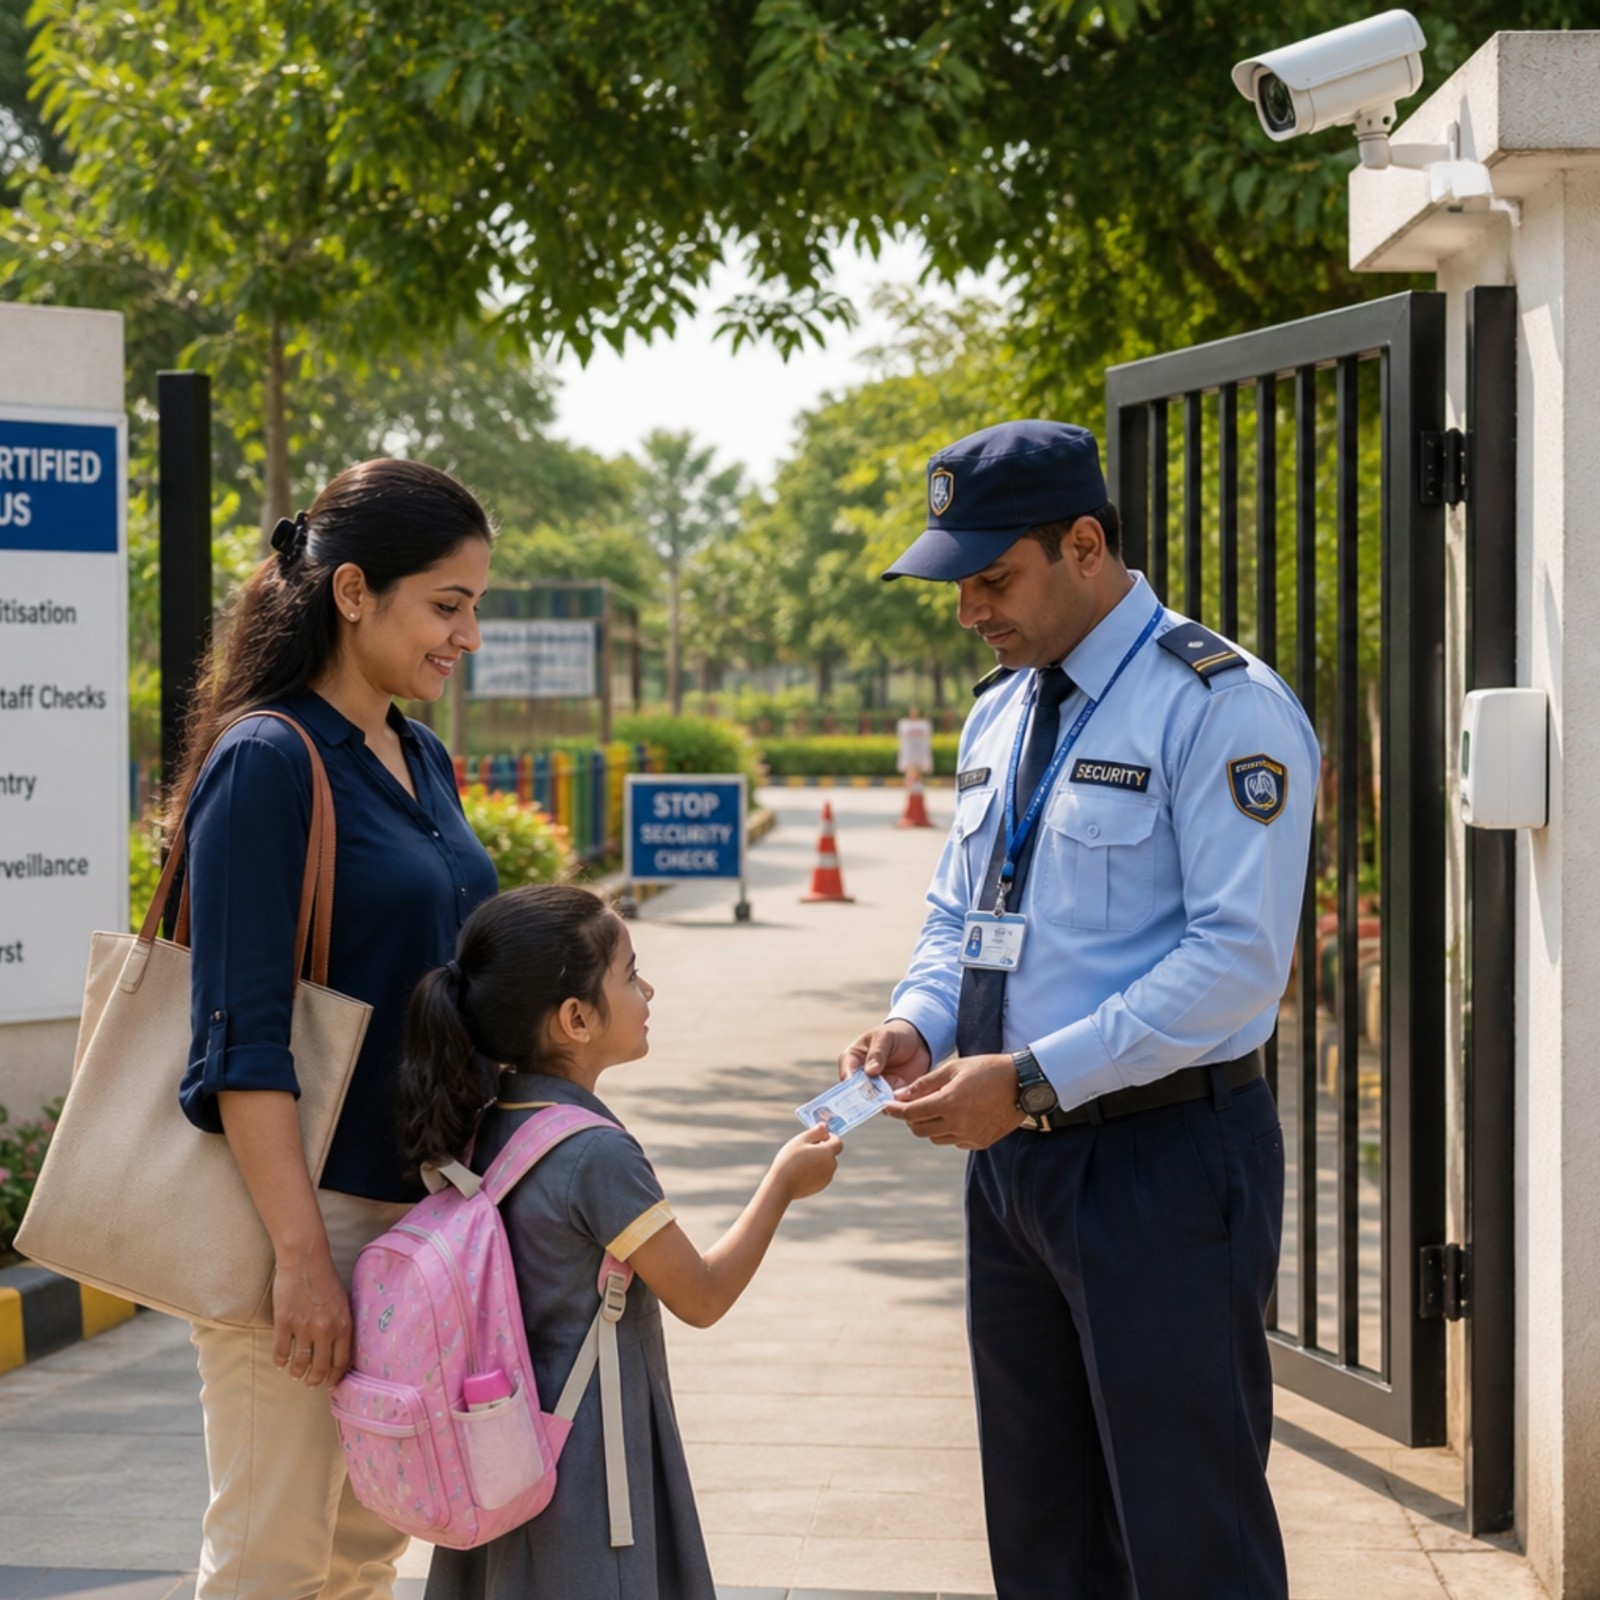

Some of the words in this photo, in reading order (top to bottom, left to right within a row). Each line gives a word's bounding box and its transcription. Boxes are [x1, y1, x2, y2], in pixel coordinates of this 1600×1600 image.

[0, 446, 102, 484] RTIFIED
[0, 492, 32, 527] US
[0, 683, 34, 710] taff
[39, 683, 106, 710] Checks
[1076, 763, 1147, 787] SECURITY
[653, 791, 720, 819] STOP
[640, 823, 733, 845] SECURITY
[653, 849, 719, 872] CHECK
